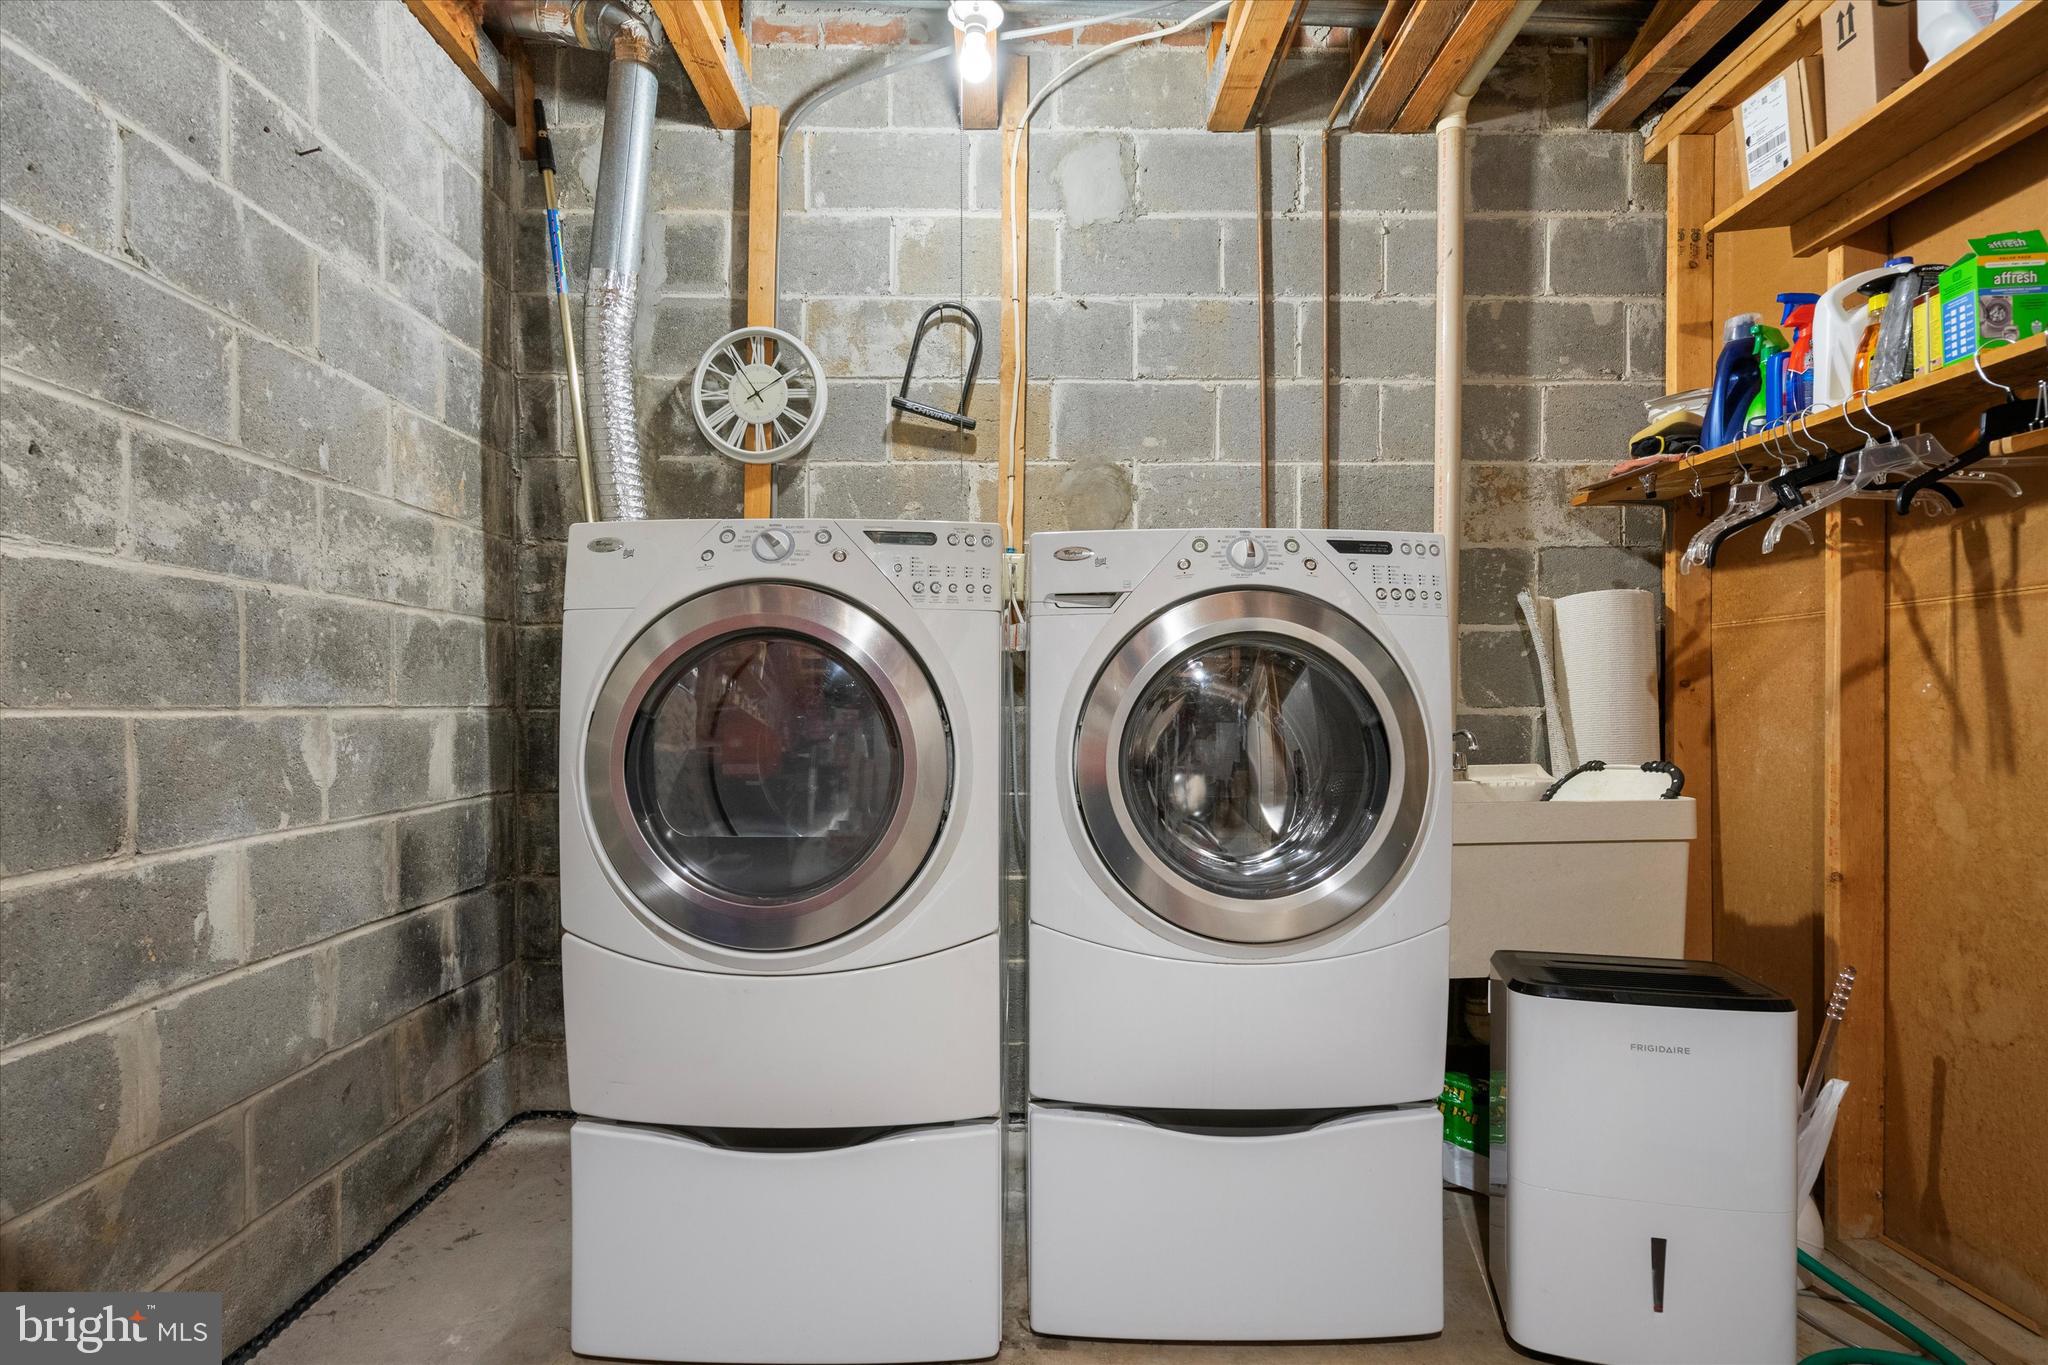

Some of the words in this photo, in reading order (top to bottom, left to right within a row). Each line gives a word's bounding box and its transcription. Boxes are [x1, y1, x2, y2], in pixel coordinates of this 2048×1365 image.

[1987, 238, 2027, 249] affresh
[1994, 270, 2038, 285] affresh
[905, 401, 953, 421] SCHWINN
[1630, 1043, 1691, 1055] FRIGIDAIRE
